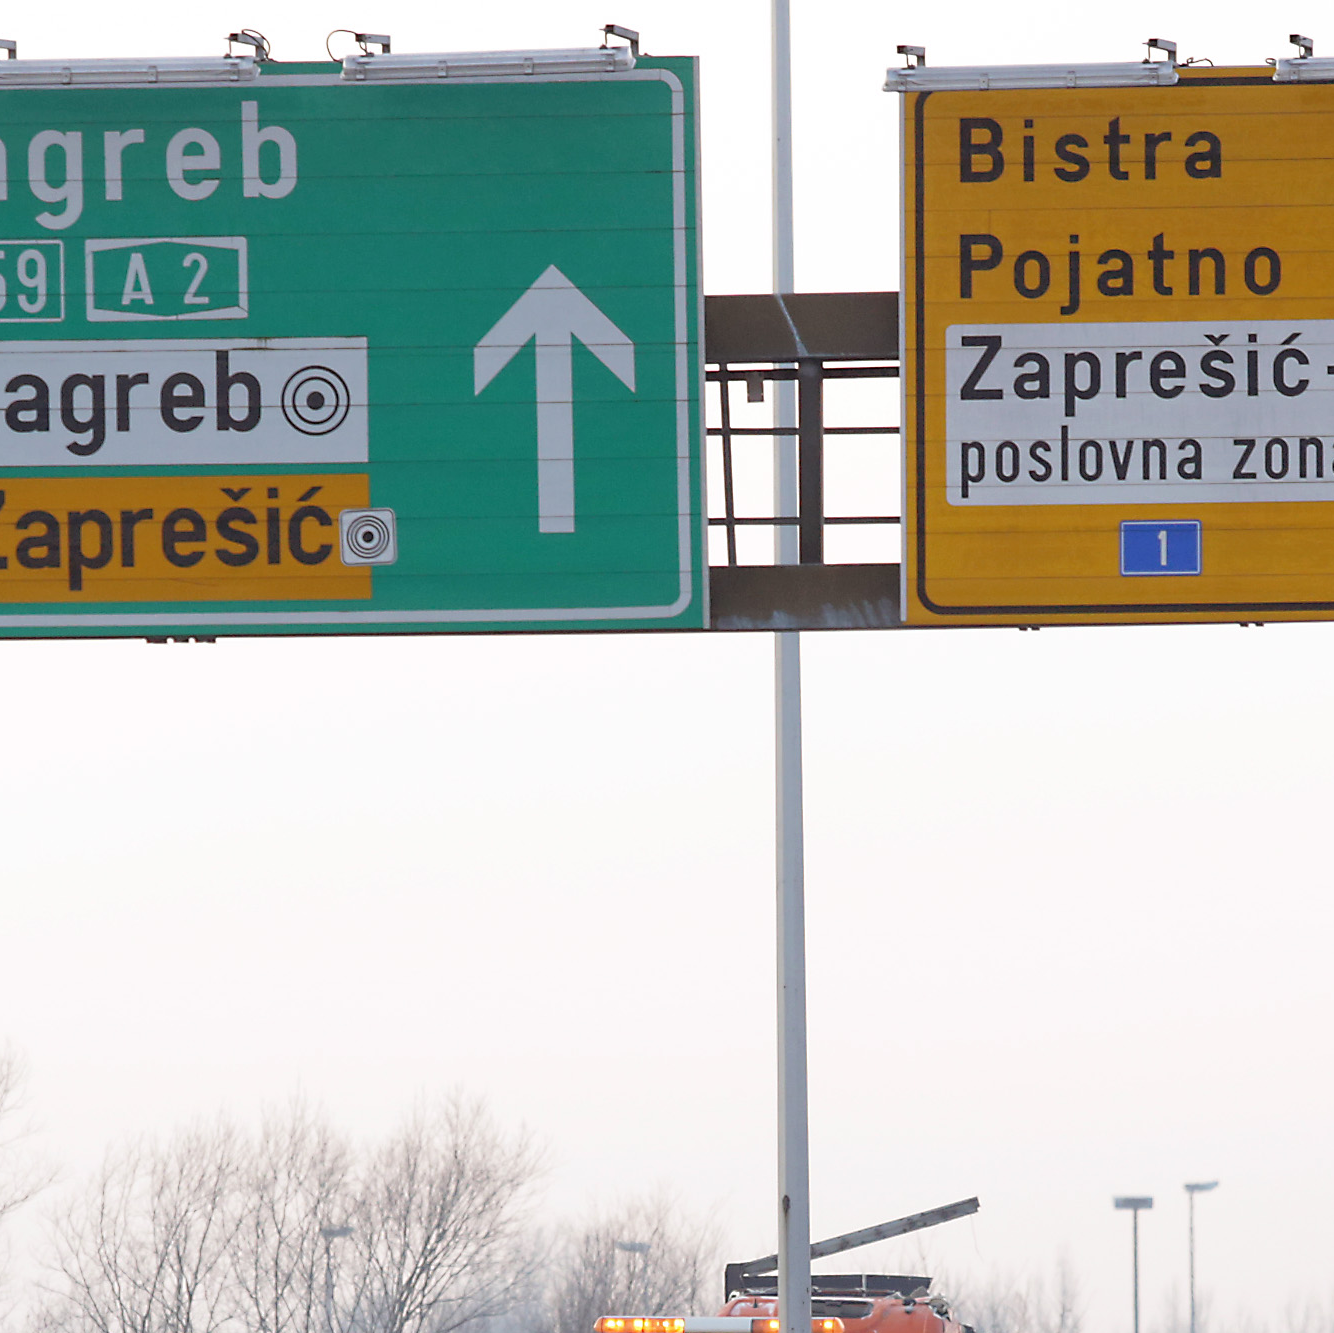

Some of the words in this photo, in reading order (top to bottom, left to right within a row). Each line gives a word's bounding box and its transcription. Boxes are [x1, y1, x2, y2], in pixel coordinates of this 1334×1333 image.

[960, 117, 1222, 182] Bistra
[122, 252, 155, 305] A
[182, 251, 210, 304] 2
[960, 233, 1282, 315] Pojatno
[961, 425, 1202, 498] poslovna
[1156, 530, 1168, 567] 1
